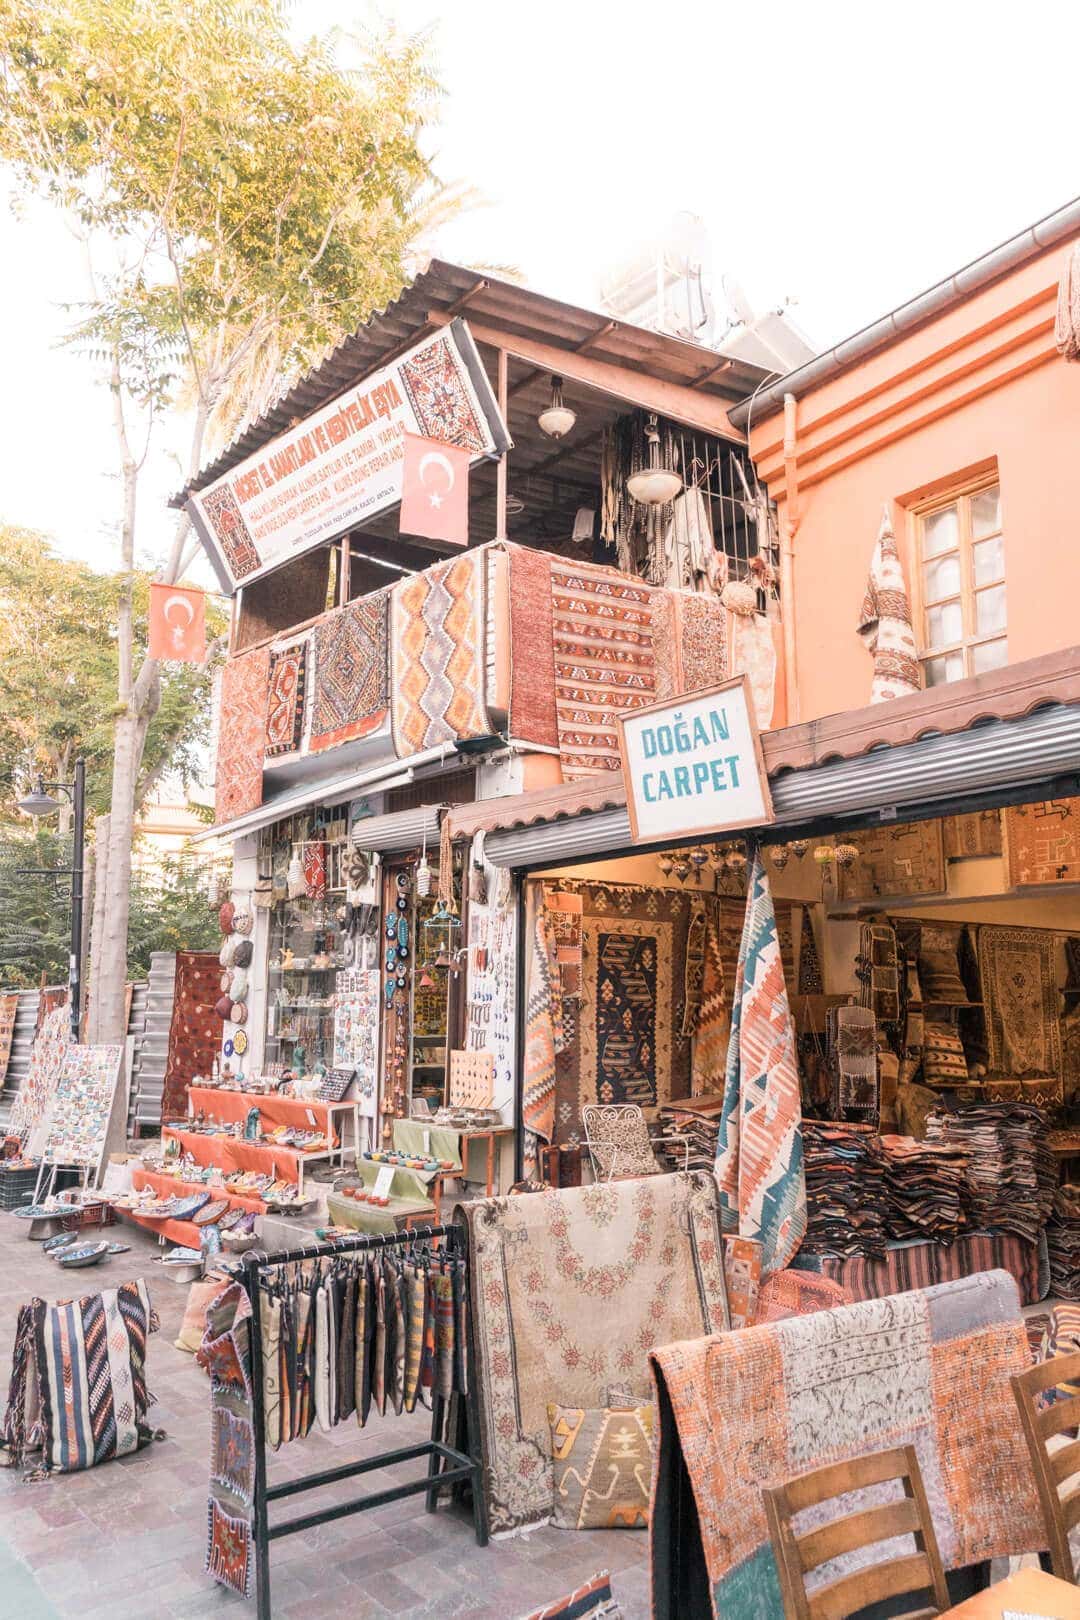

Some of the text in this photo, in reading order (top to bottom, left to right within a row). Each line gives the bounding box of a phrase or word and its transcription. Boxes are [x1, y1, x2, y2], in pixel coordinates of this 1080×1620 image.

[258, 461, 274, 488] EL
[268, 435, 317, 482] SANATLARI
[310, 426, 330, 454] VE
[323, 391, 377, 447] HEDİYELİK
[370, 379, 403, 421] EŞYA
[341, 452, 354, 467] VE
[641, 708, 730, 759] DOĞAN
[642, 755, 740, 802] CARPET
